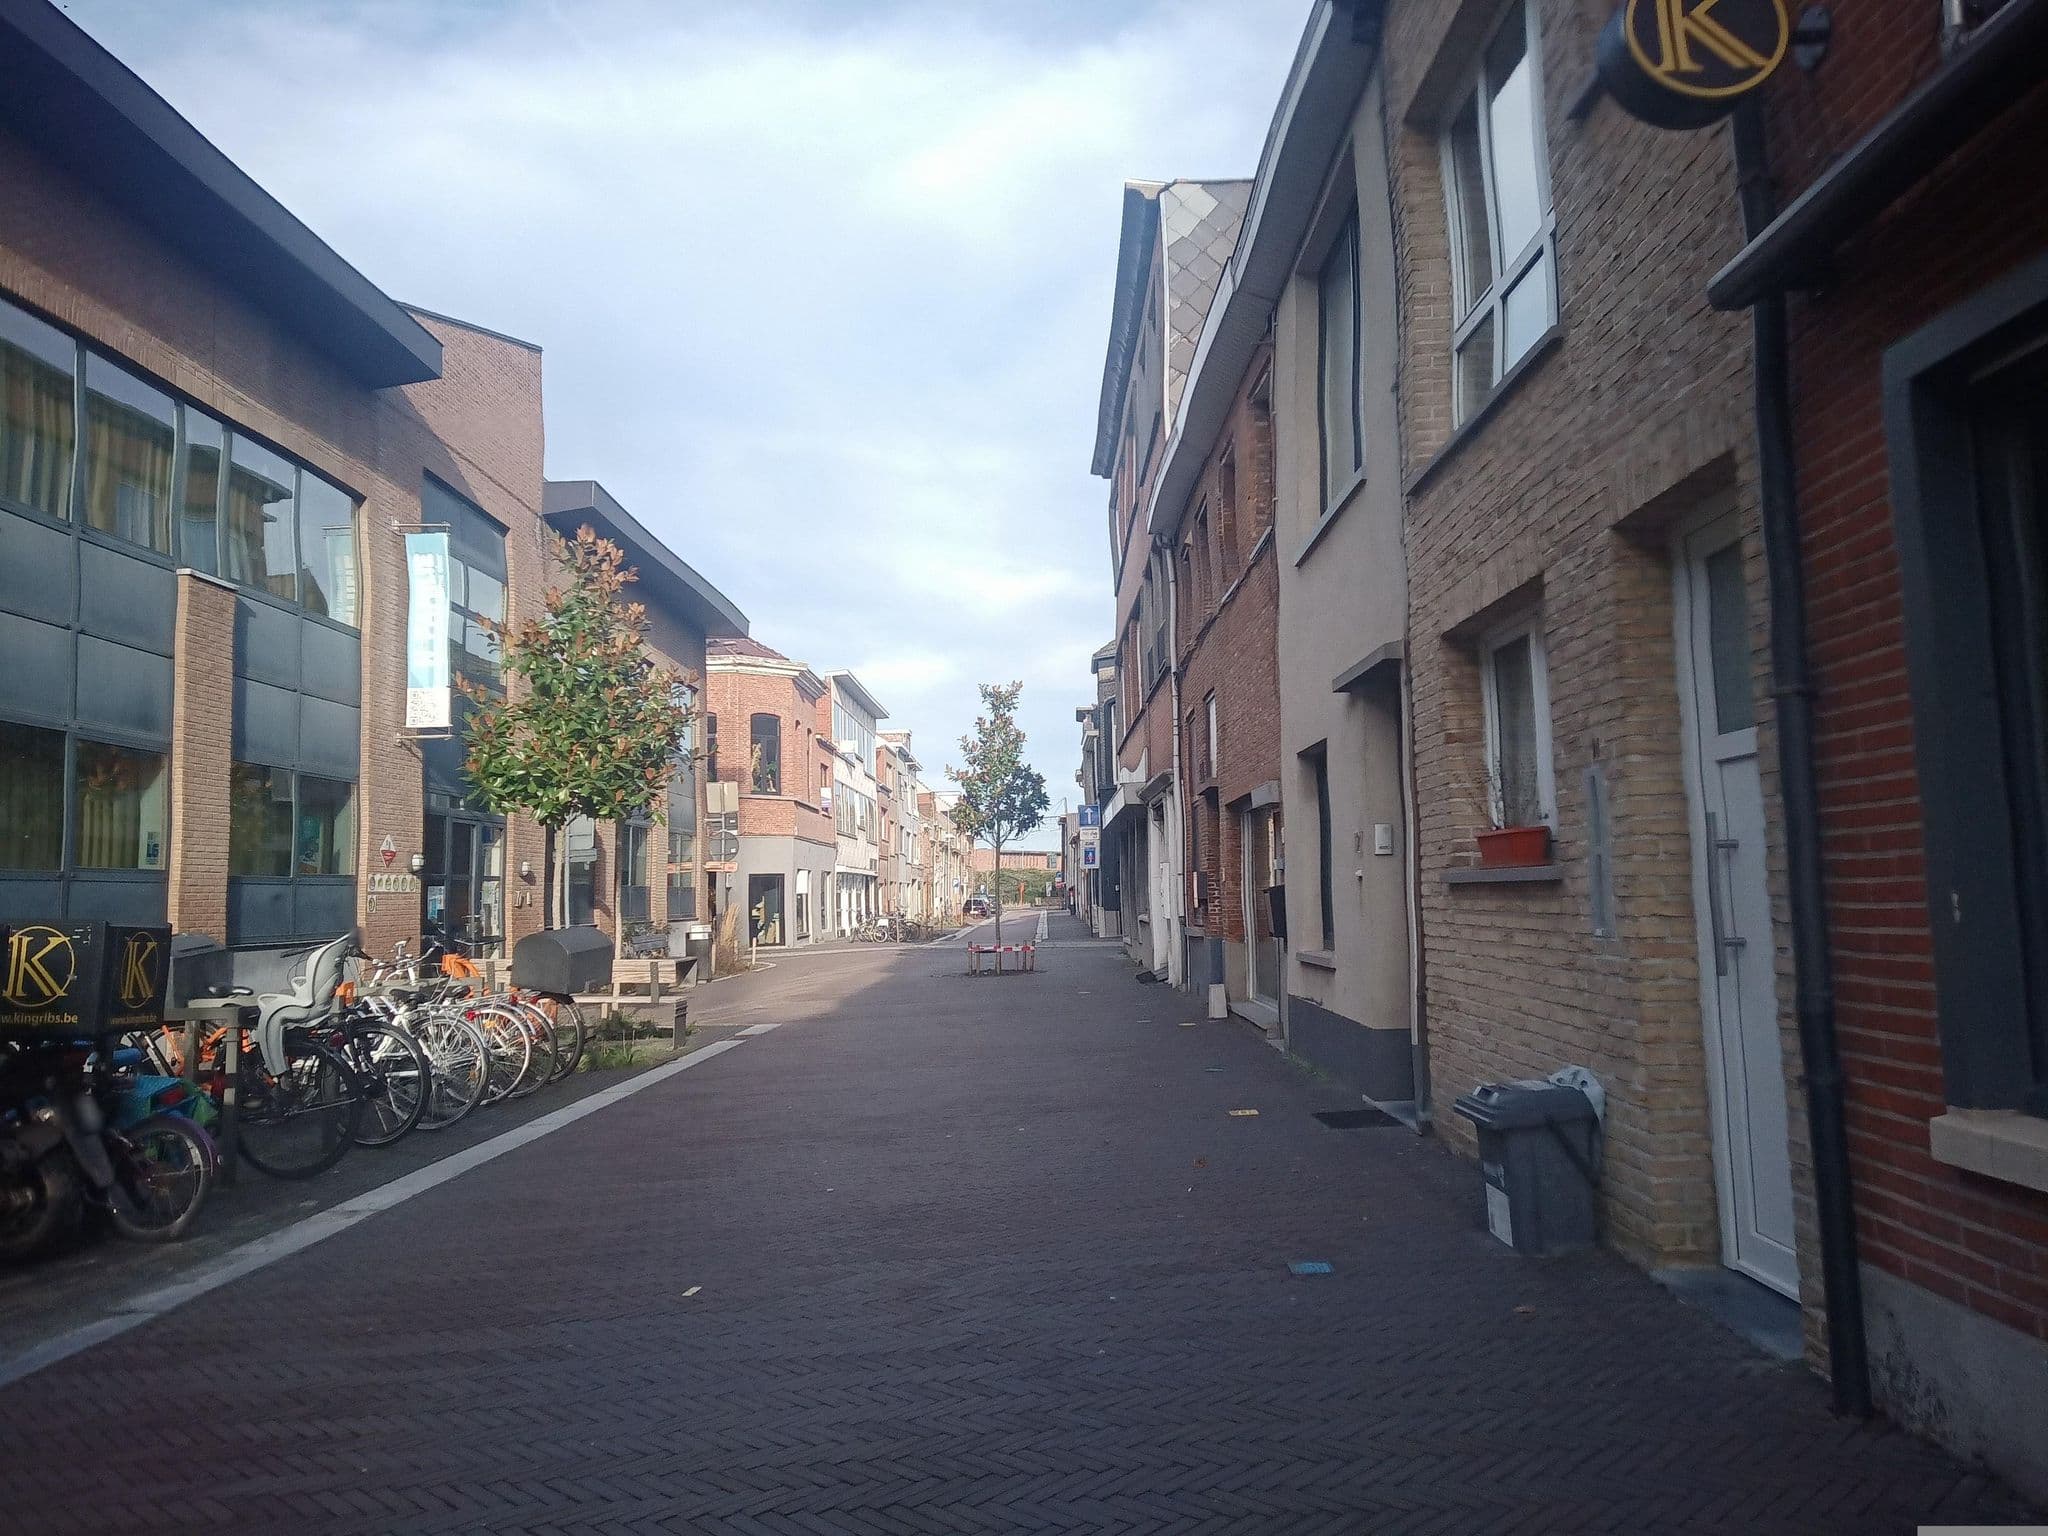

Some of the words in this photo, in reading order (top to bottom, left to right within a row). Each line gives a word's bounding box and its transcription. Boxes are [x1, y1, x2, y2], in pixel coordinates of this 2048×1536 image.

[1653, 0, 1772, 72] K
[3, 936, 71, 998] K
[121, 941, 158, 999] K
